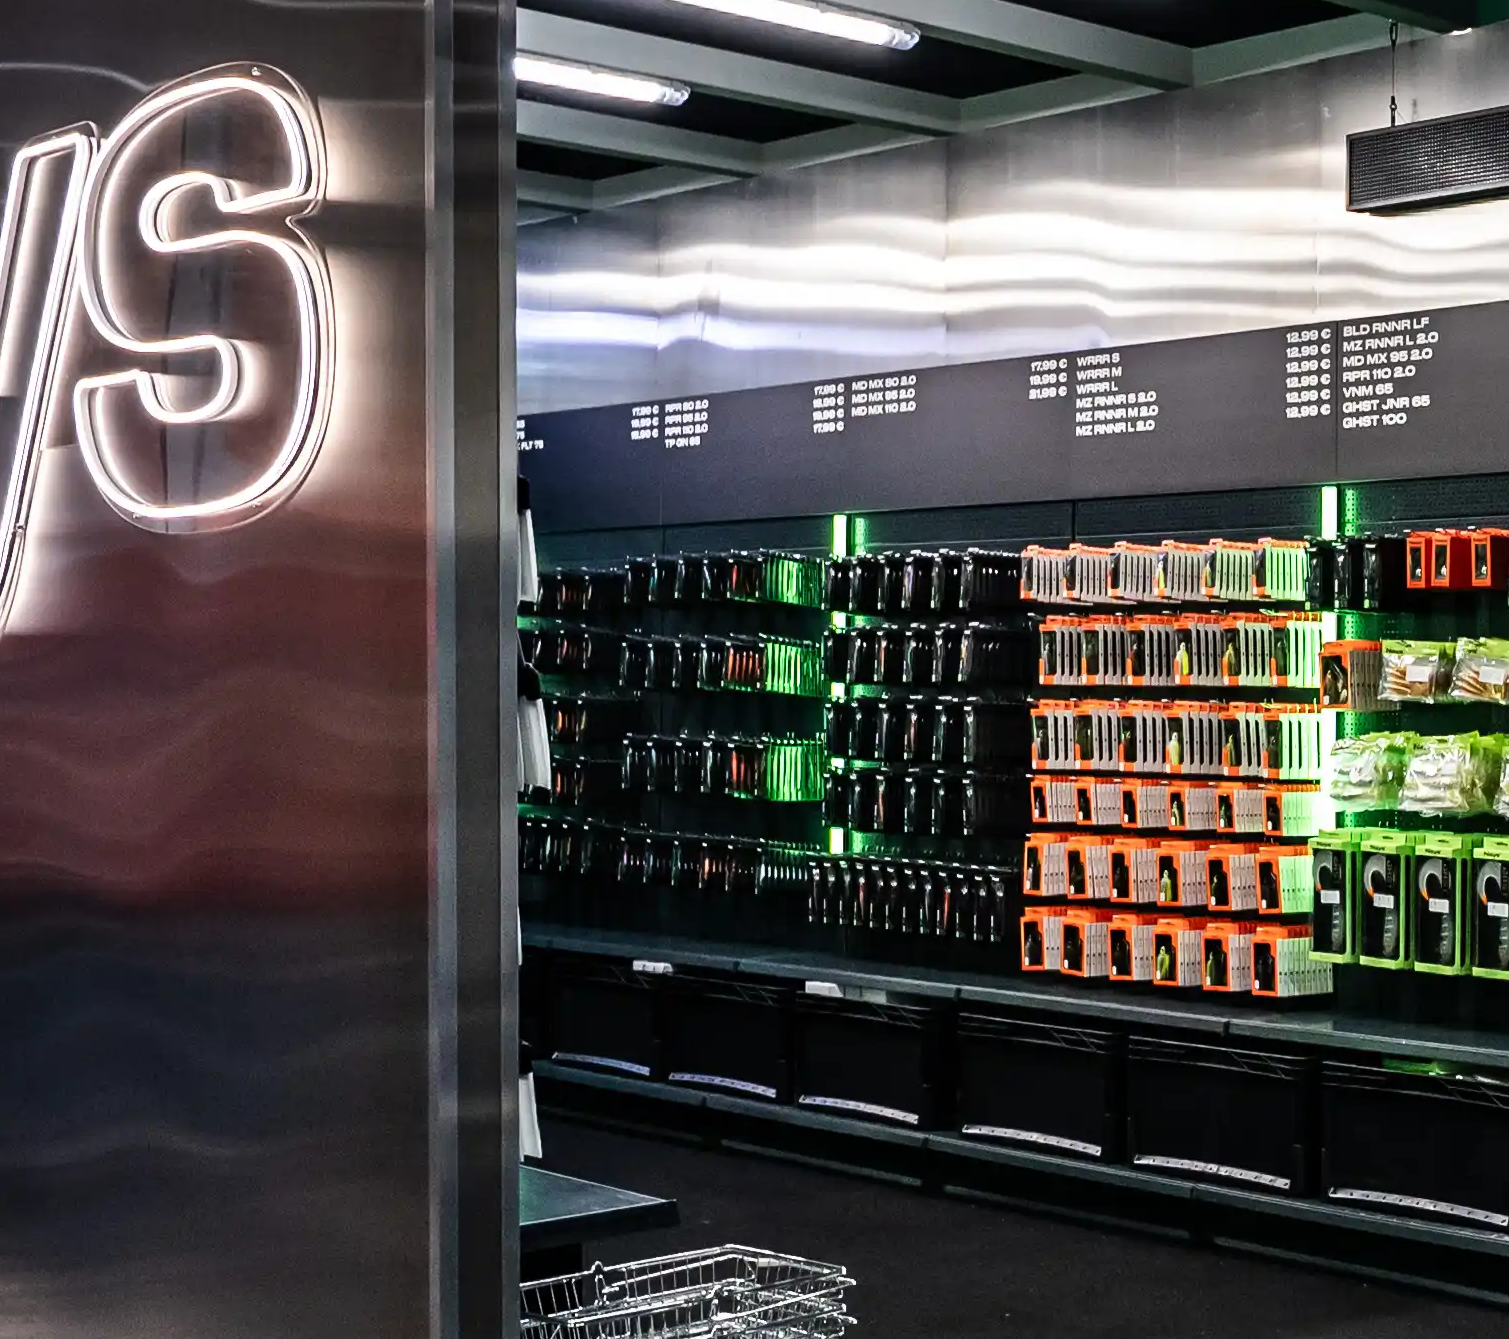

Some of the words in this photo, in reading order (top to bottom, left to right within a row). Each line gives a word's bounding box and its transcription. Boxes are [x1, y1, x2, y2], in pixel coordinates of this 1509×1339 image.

[1321, 328, 1331, 340] €
[1343, 325, 1370, 337] BLD
[1372, 320, 1411, 334] RNNR
[1413, 317, 1430, 329] LF
[1343, 341, 1363, 352] MZ
[1365, 336, 1404, 350] RNNR
[1406, 335, 1414, 346] L
[1416, 331, 1439, 344] 2.0
[1321, 344, 1331, 355] €
[1320, 359, 1331, 370] €
[1343, 355, 1364, 367] MD
[1367, 353, 1387, 365] MX
[1389, 351, 1408, 363] 95
[1410, 348, 1433, 361] 2.0
[1320, 373, 1331, 385] €
[1343, 370, 1370, 382] RPR
[1372, 368, 1391, 380] 110
[1393, 365, 1416, 378] 2.0
[1320, 389, 1331, 400] €
[1343, 385, 1373, 398] VNM
[1375, 383, 1393, 395] 65
[1320, 404, 1331, 416] €
[1343, 400, 1380, 413] GHST
[1381, 397, 1410, 410] JNR
[1411, 395, 1431, 407] 65
[1343, 415, 1379, 429] GHST
[1381, 412, 1407, 425] 100
